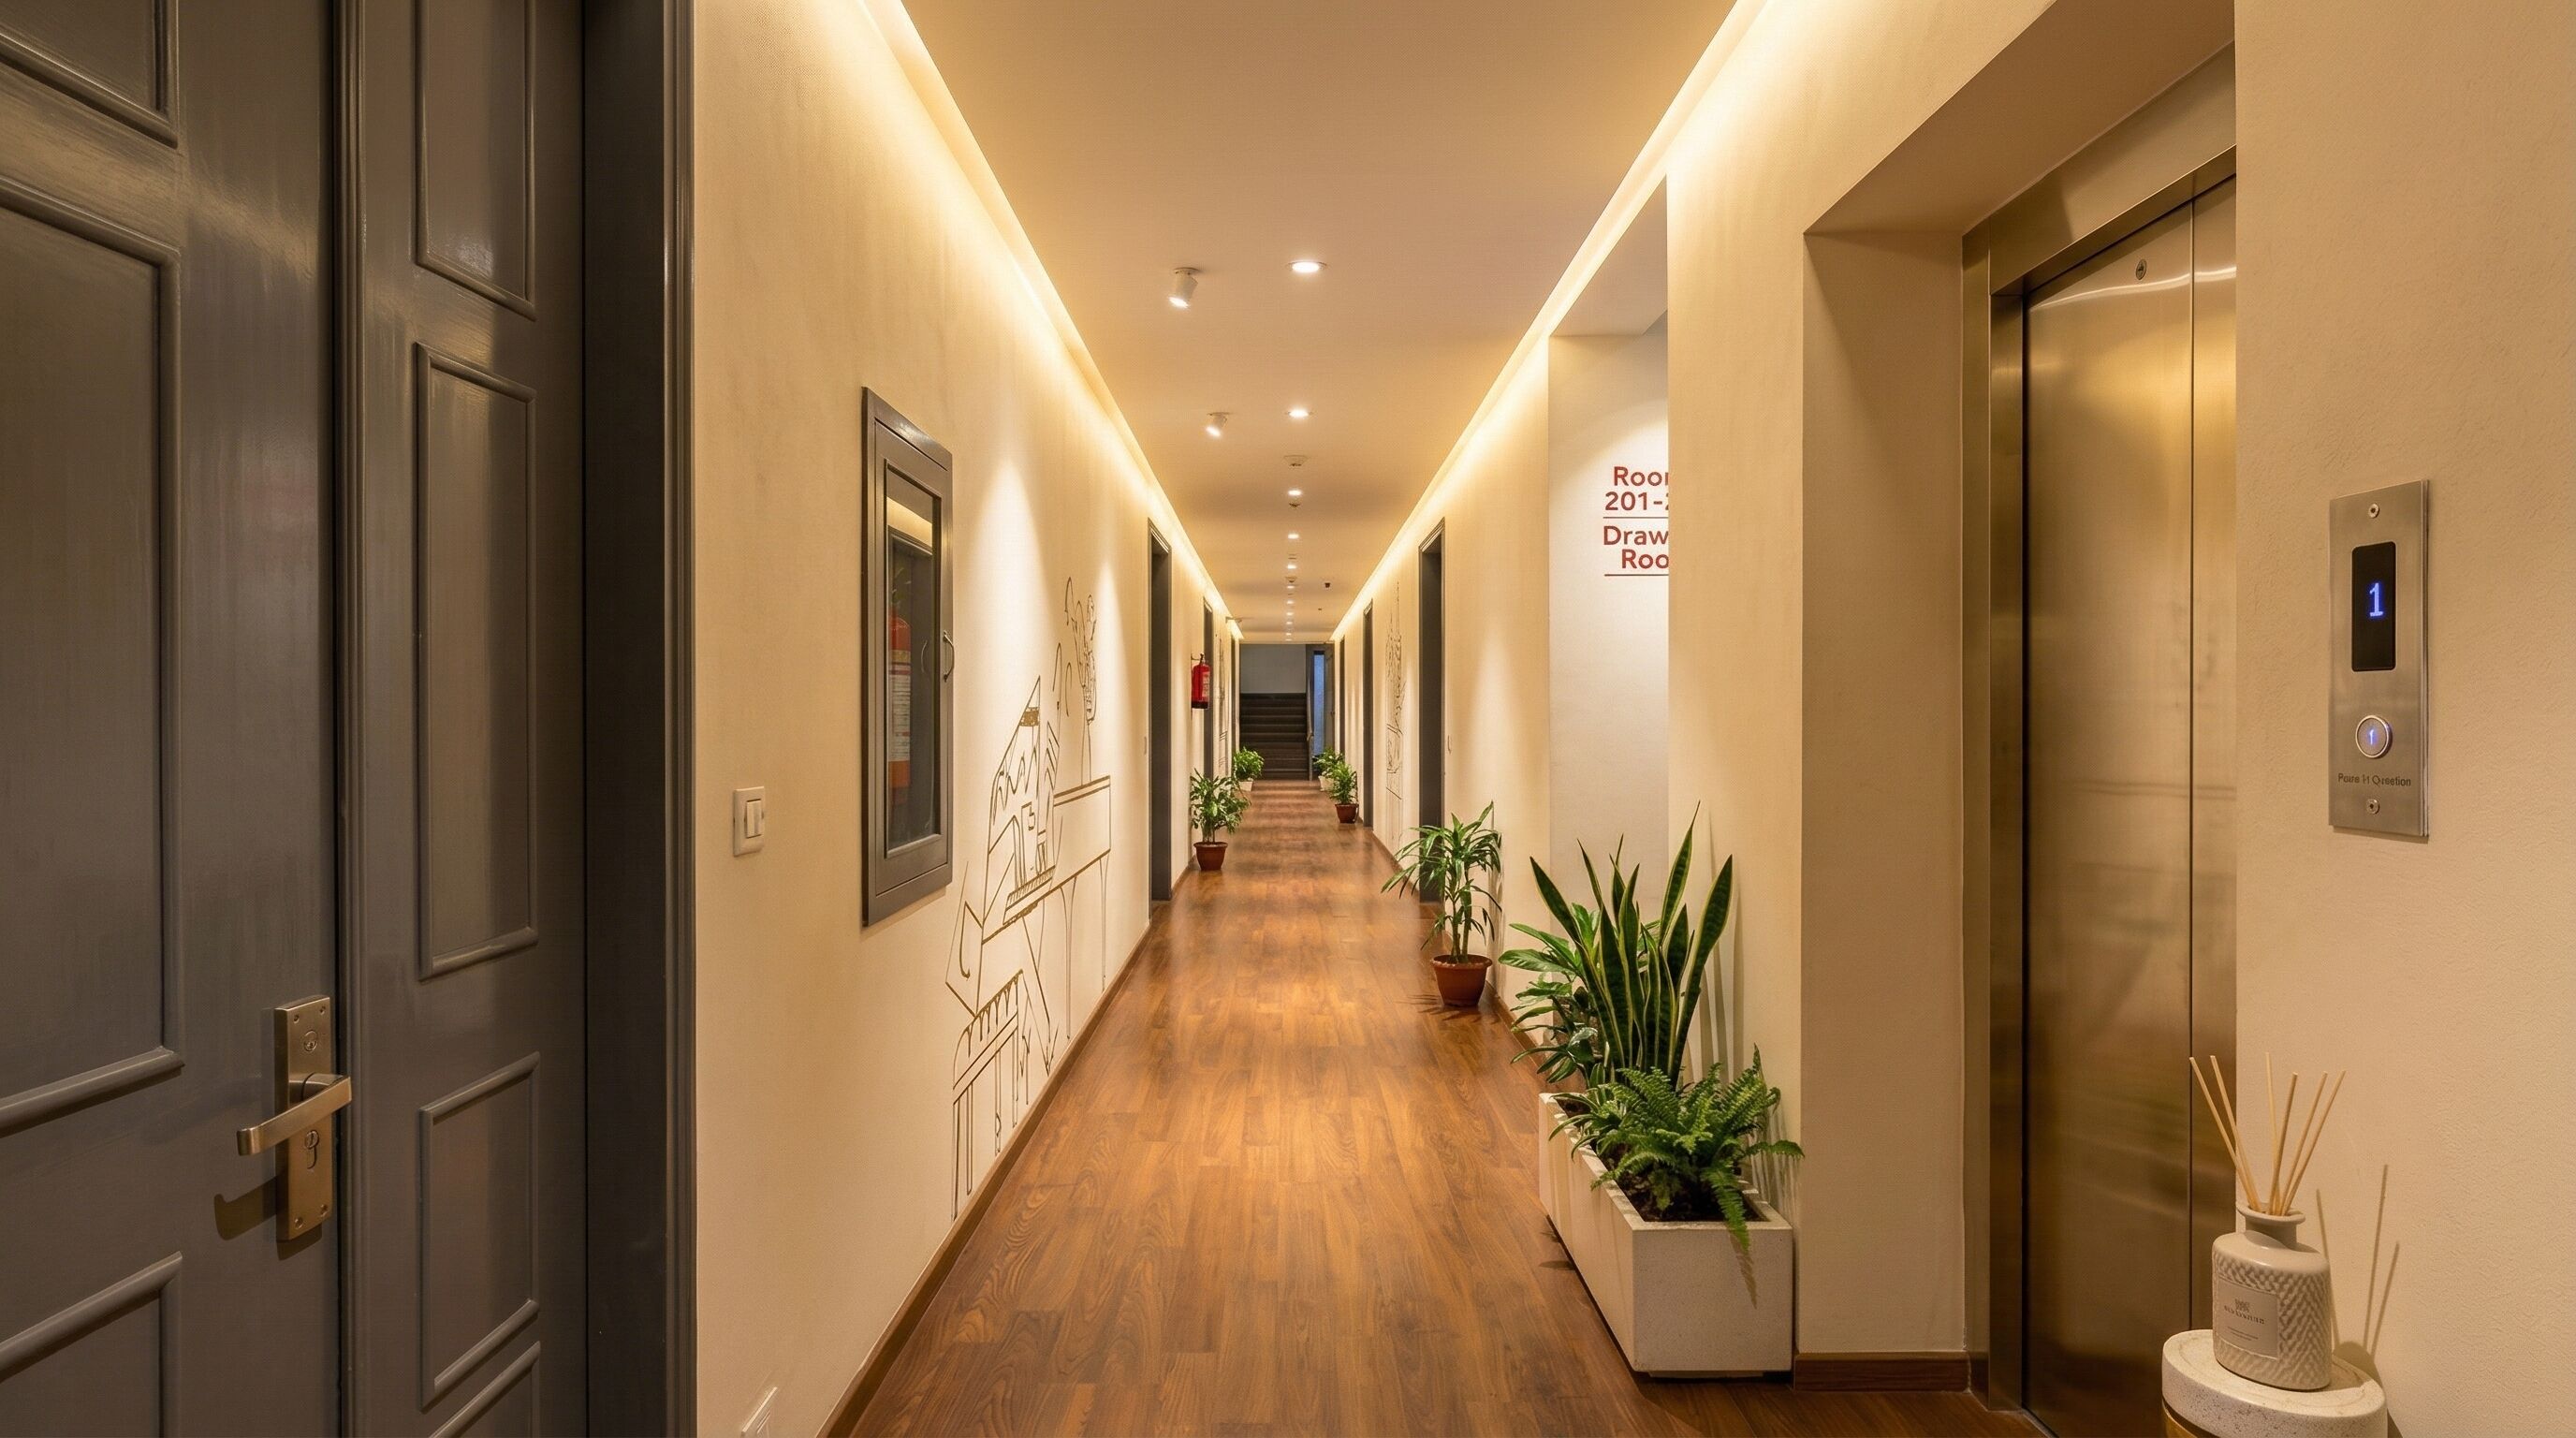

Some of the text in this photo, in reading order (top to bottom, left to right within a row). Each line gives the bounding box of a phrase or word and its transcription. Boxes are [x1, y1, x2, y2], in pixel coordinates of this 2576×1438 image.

[1614, 465, 1669, 486] Roo
[1604, 491, 1669, 511] 201-
[2369, 582, 2384, 617] 1
